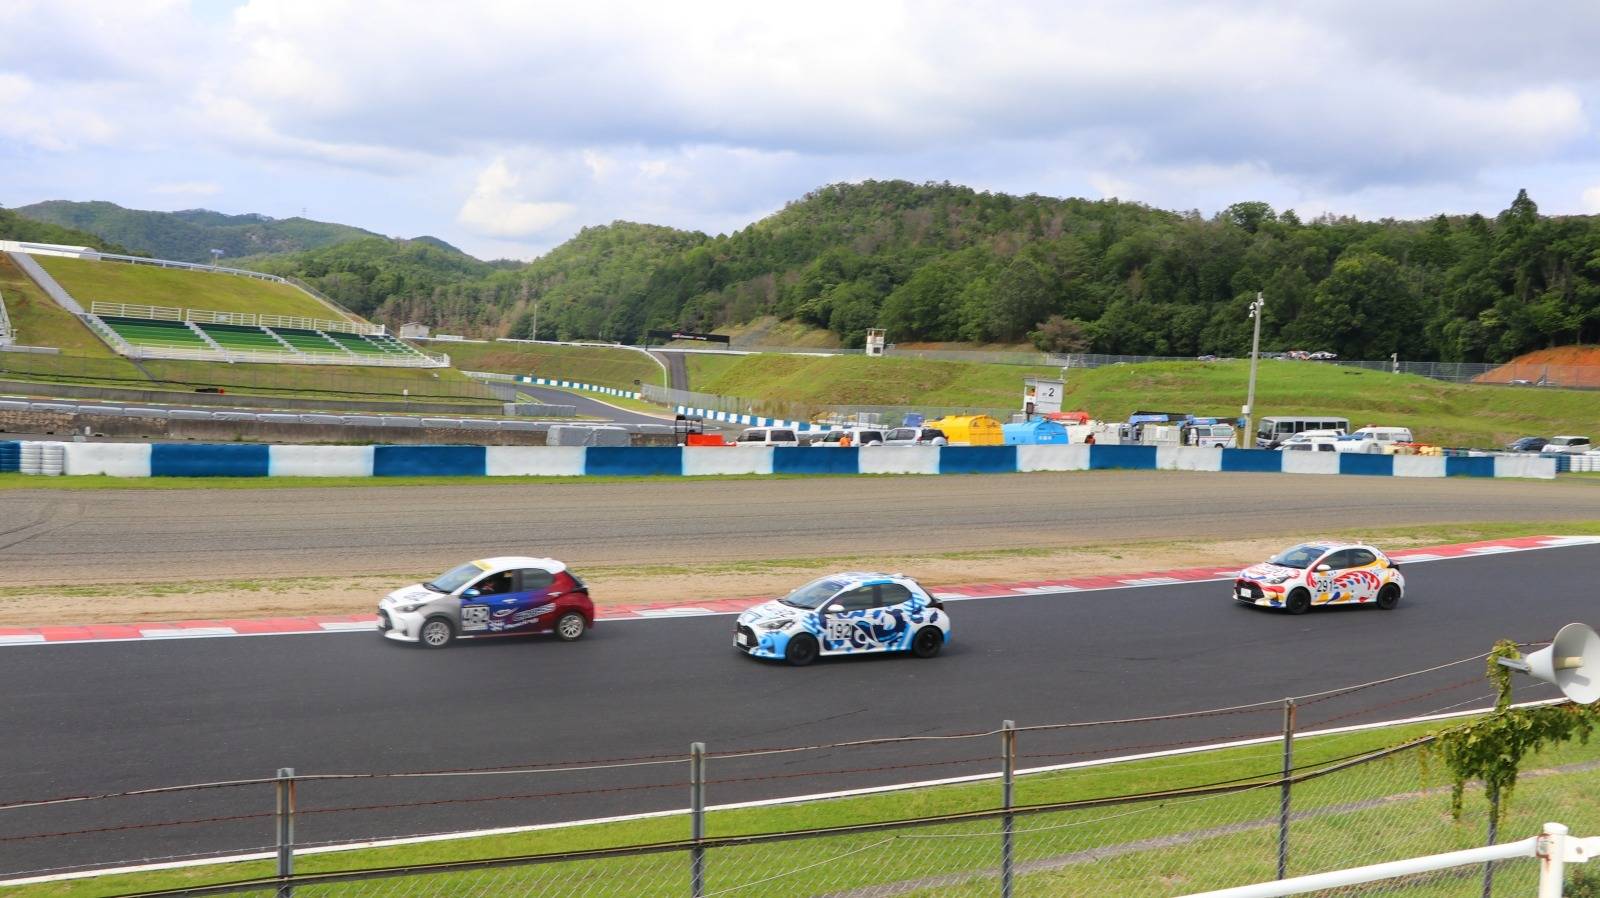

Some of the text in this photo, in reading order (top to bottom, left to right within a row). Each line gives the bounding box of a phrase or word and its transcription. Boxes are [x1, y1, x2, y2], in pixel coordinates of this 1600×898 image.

[1048, 387, 1055, 397] 2
[1317, 580, 1332, 592] 291
[829, 623, 850, 639] 192
